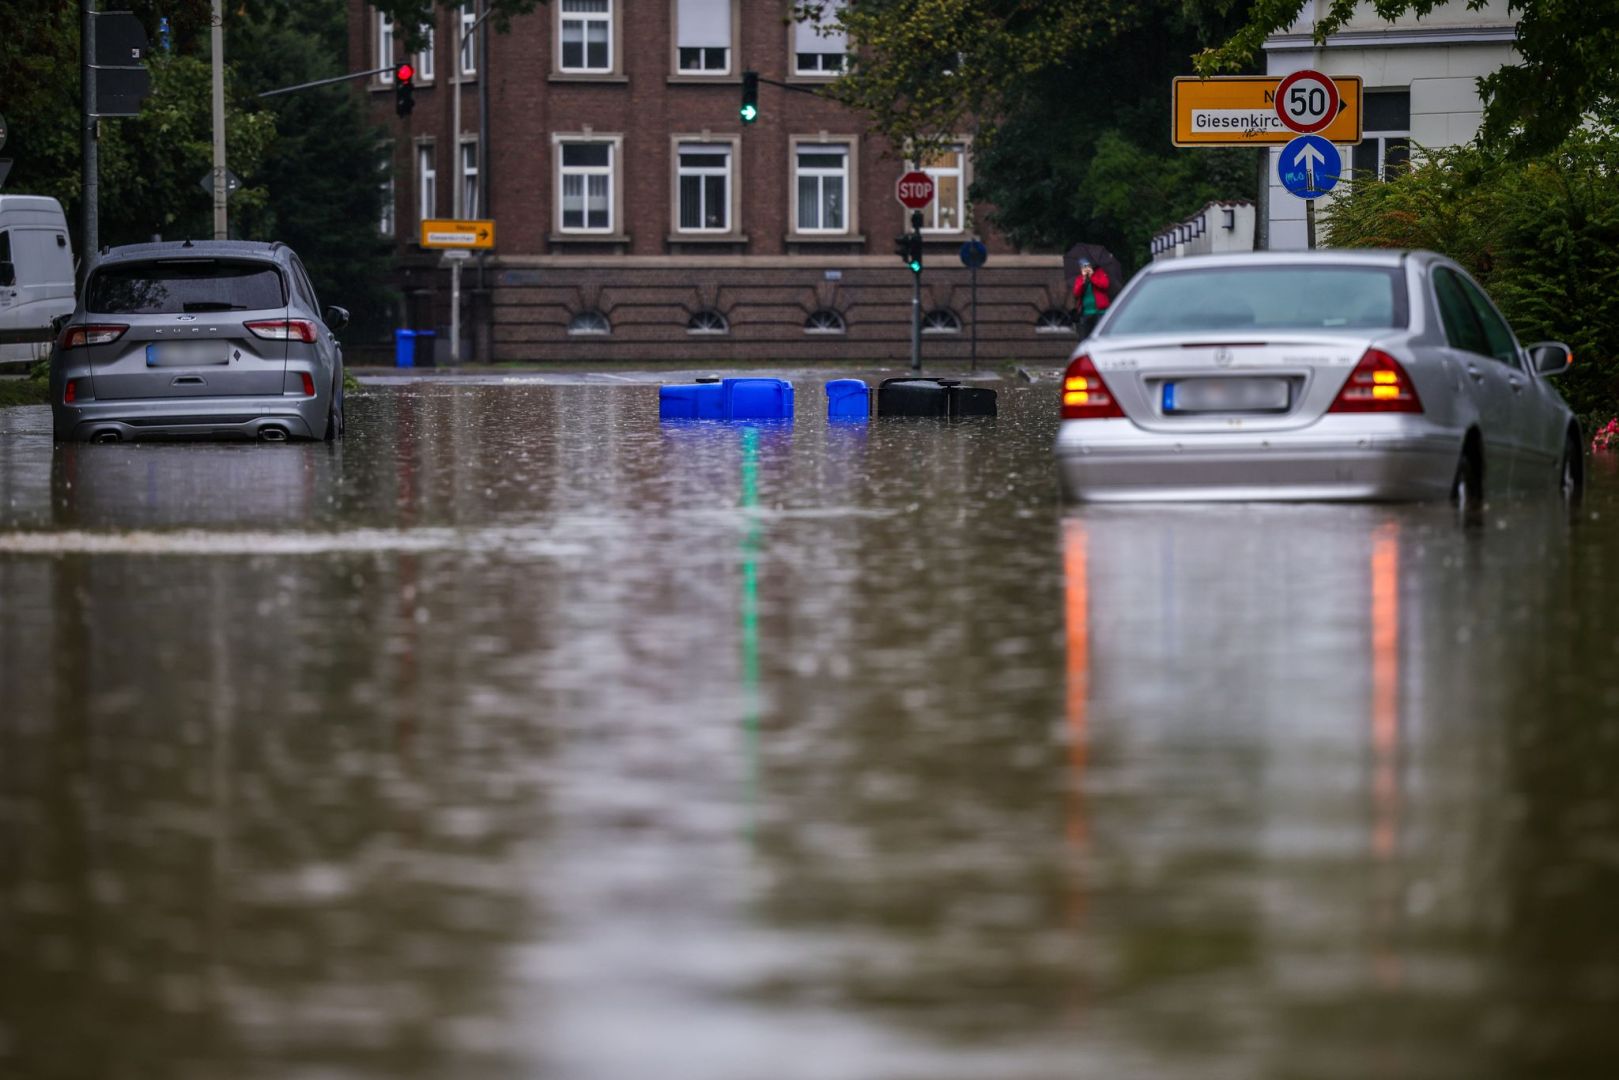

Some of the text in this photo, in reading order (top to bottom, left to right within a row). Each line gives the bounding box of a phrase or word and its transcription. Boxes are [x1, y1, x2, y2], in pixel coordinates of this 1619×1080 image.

[1264, 90, 1274, 103] N
[1290, 88, 1325, 116] 50
[1196, 113, 1284, 128] Giesenkirc
[900, 182, 932, 198] STOP
